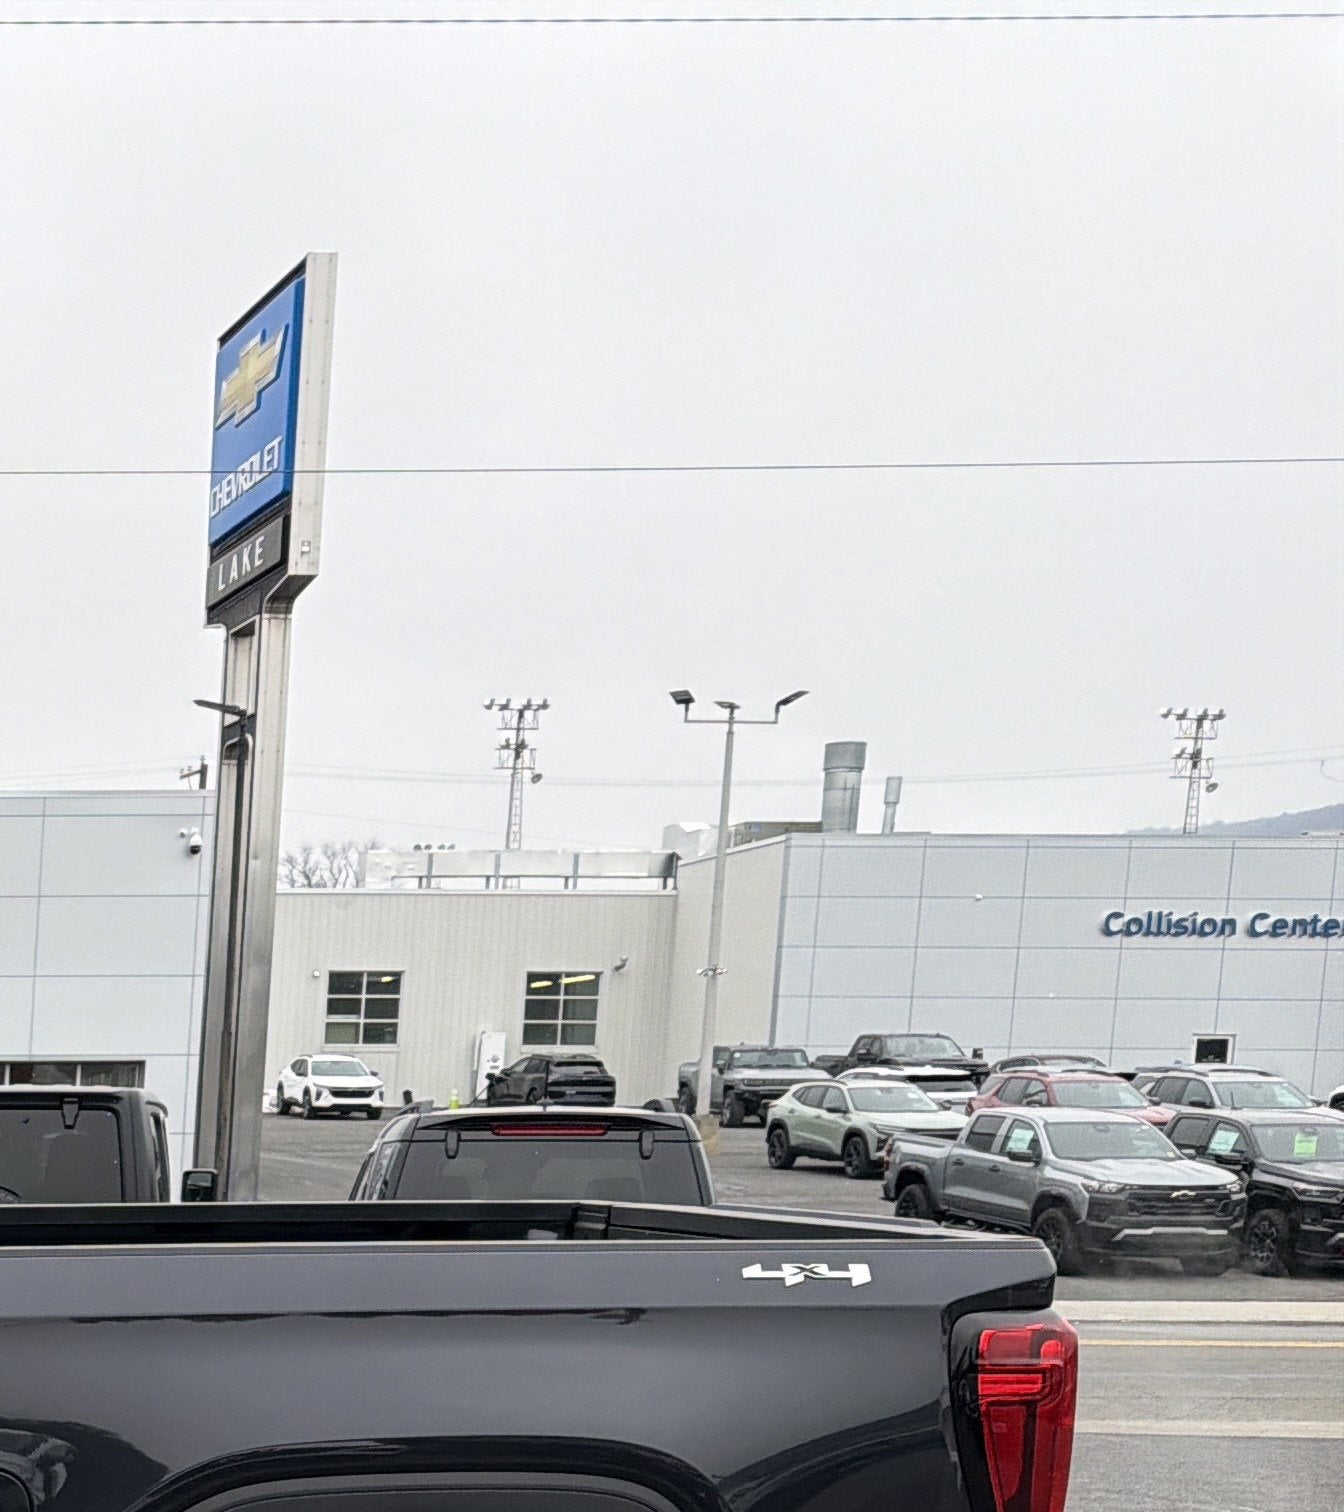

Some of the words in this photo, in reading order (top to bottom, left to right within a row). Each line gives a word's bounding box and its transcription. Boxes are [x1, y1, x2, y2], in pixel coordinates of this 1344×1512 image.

[210, 436, 283, 518] CHEVROLET
[217, 534, 266, 591] LAKE
[1101, 910, 1238, 938] Collision
[1246, 911, 1344, 939] Cente
